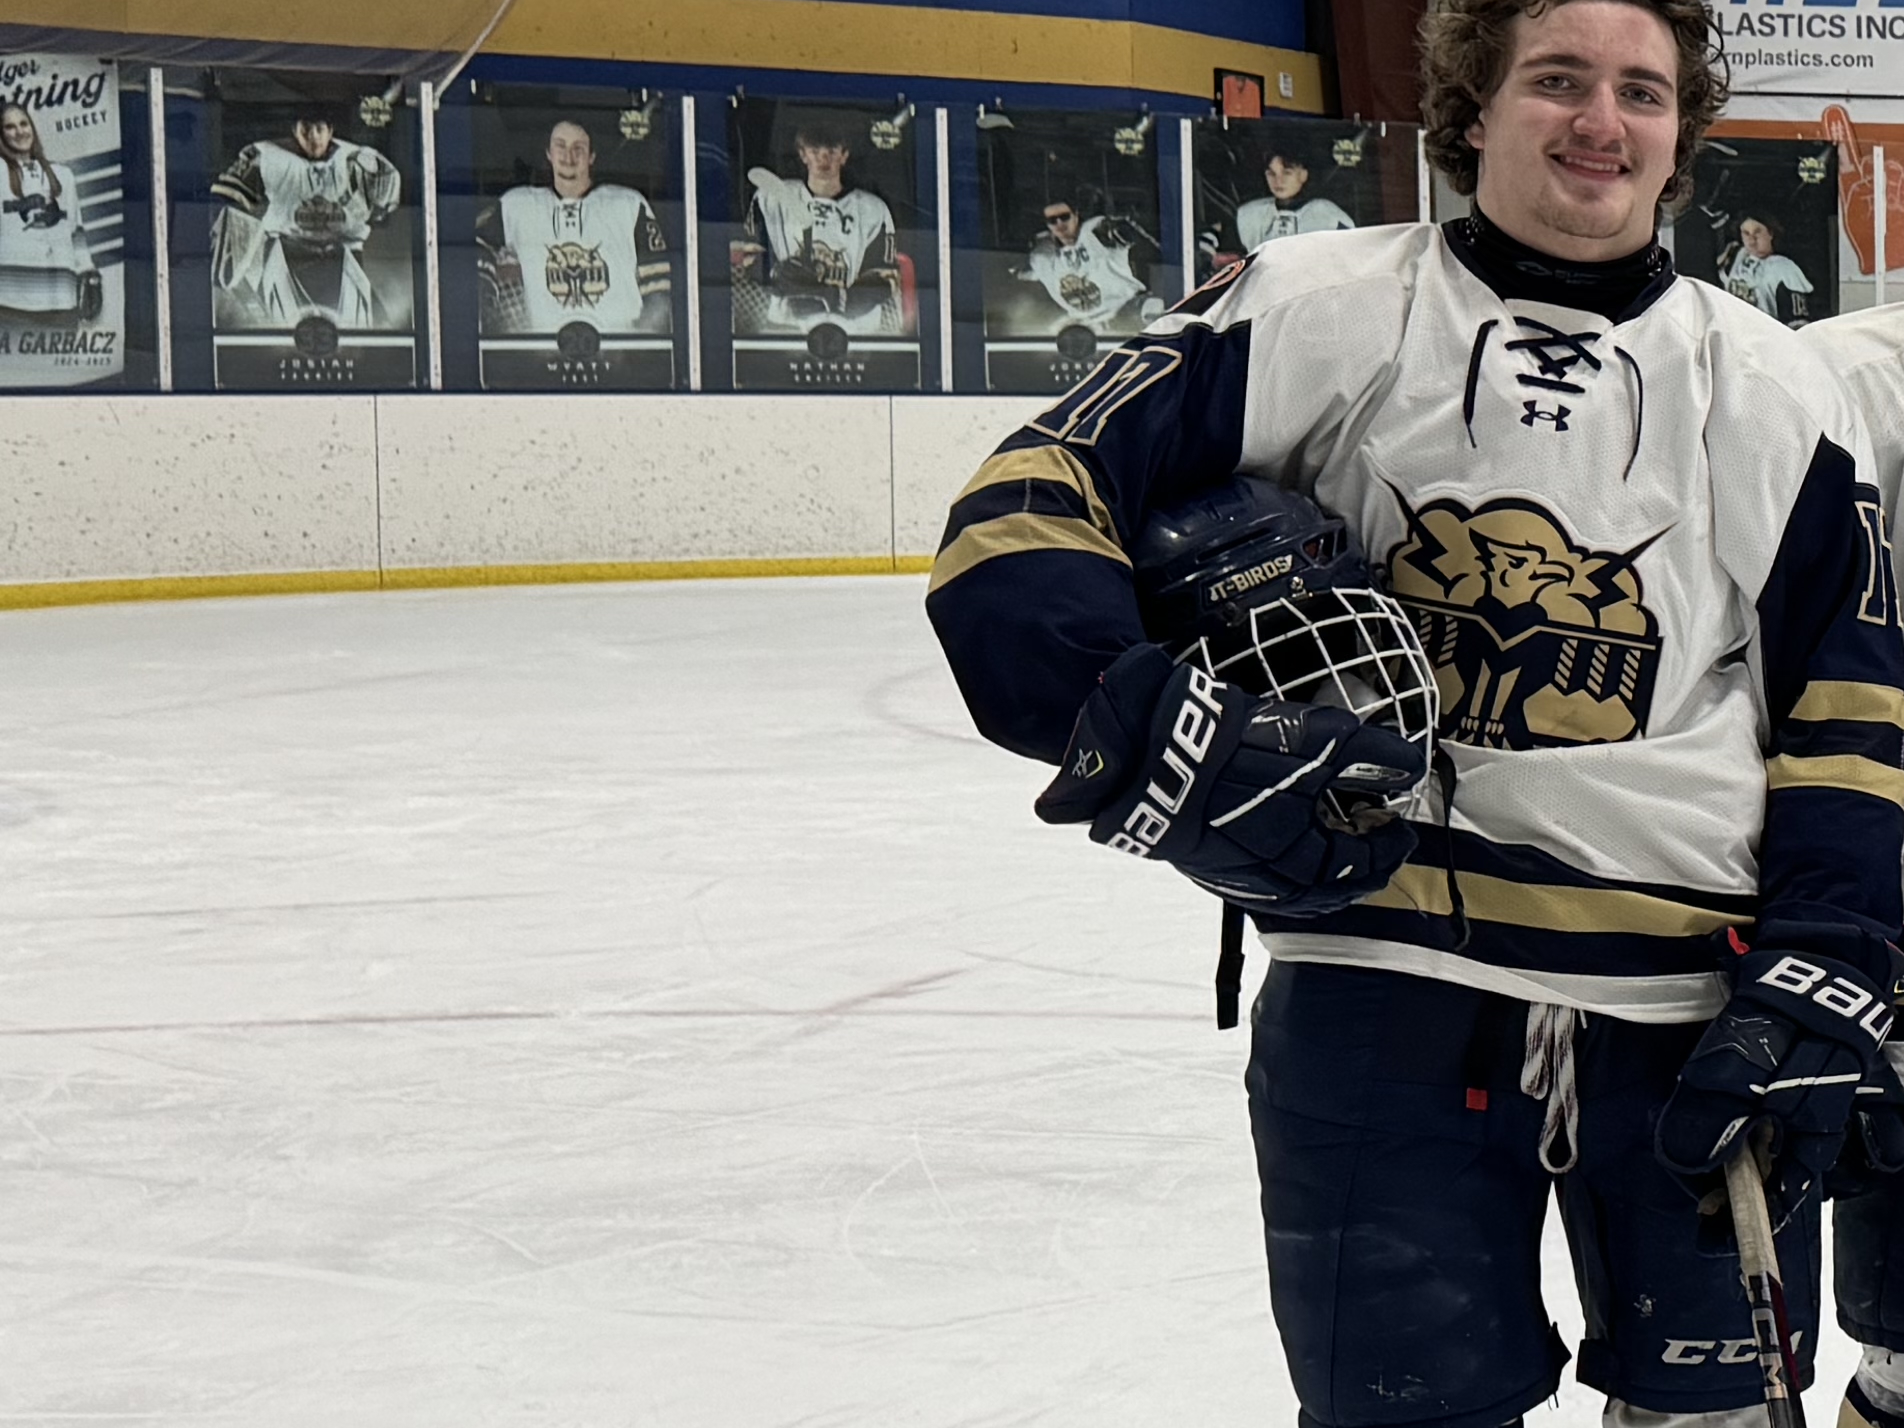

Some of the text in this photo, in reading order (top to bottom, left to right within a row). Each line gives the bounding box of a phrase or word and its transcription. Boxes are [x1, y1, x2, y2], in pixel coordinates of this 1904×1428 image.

[1717, 12, 1846, 38] LASTICS
[55, 110, 107, 133] HOCKEY
[18, 330, 116, 355] GARBACZ
[546, 361, 612, 371] WYATT
[789, 363, 866, 372] NATHAN
[1756, 956, 1898, 1050] BAU
